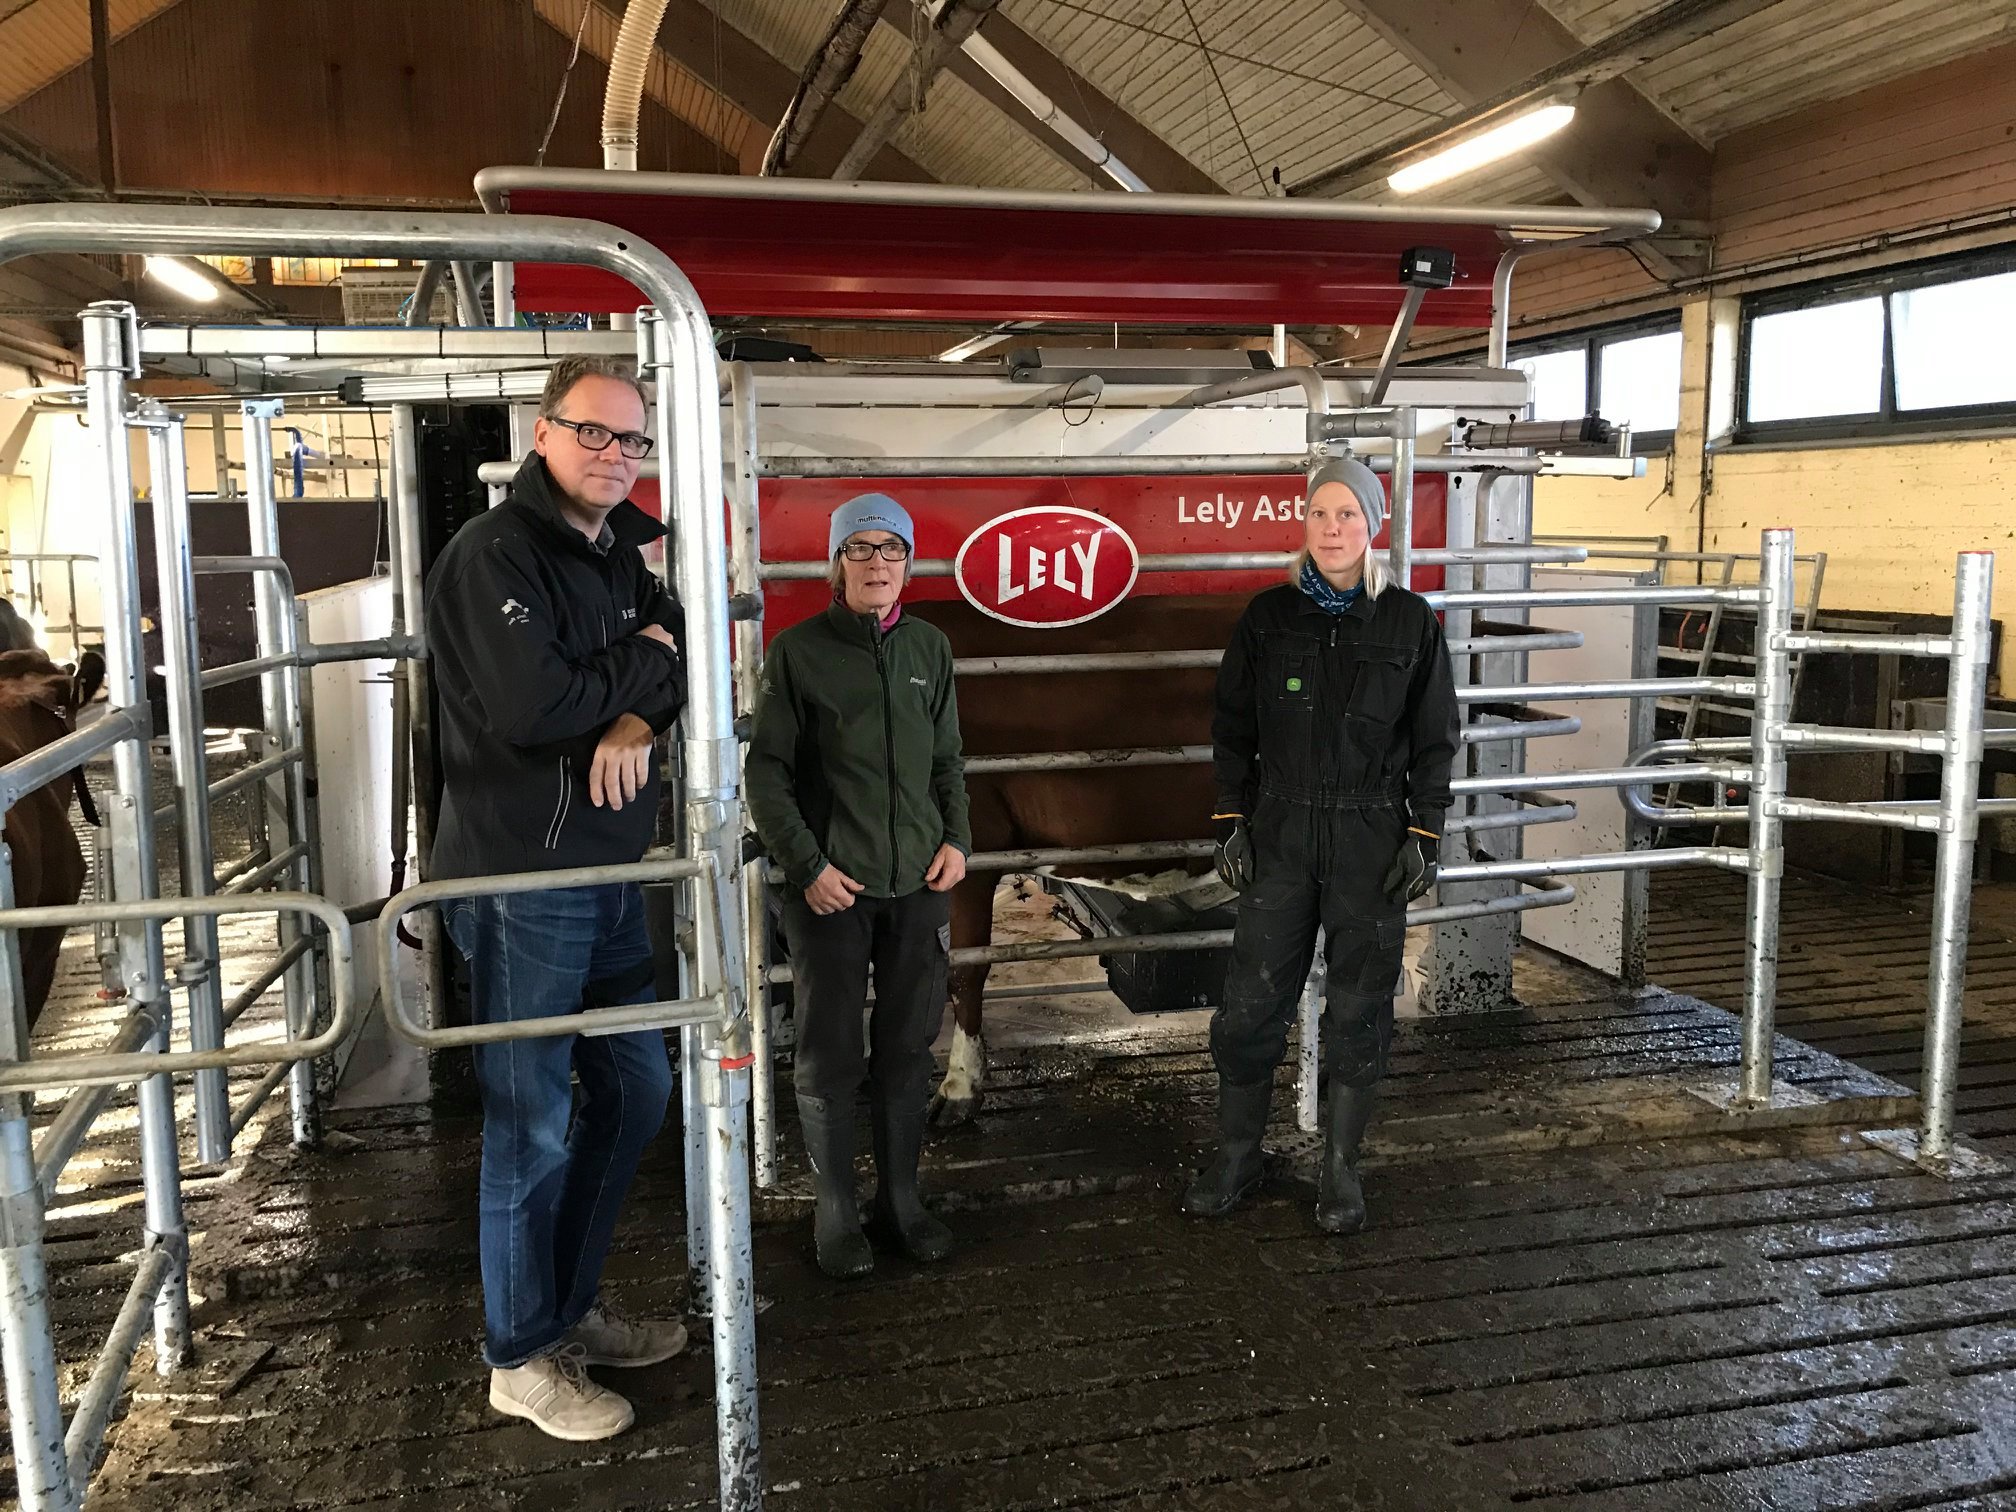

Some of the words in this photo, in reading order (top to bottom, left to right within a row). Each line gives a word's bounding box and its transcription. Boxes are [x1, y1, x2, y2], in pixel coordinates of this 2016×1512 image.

[1178, 493, 1244, 529] Lely
[1252, 494, 1306, 522] Ast
[997, 530, 1103, 605] LELY
